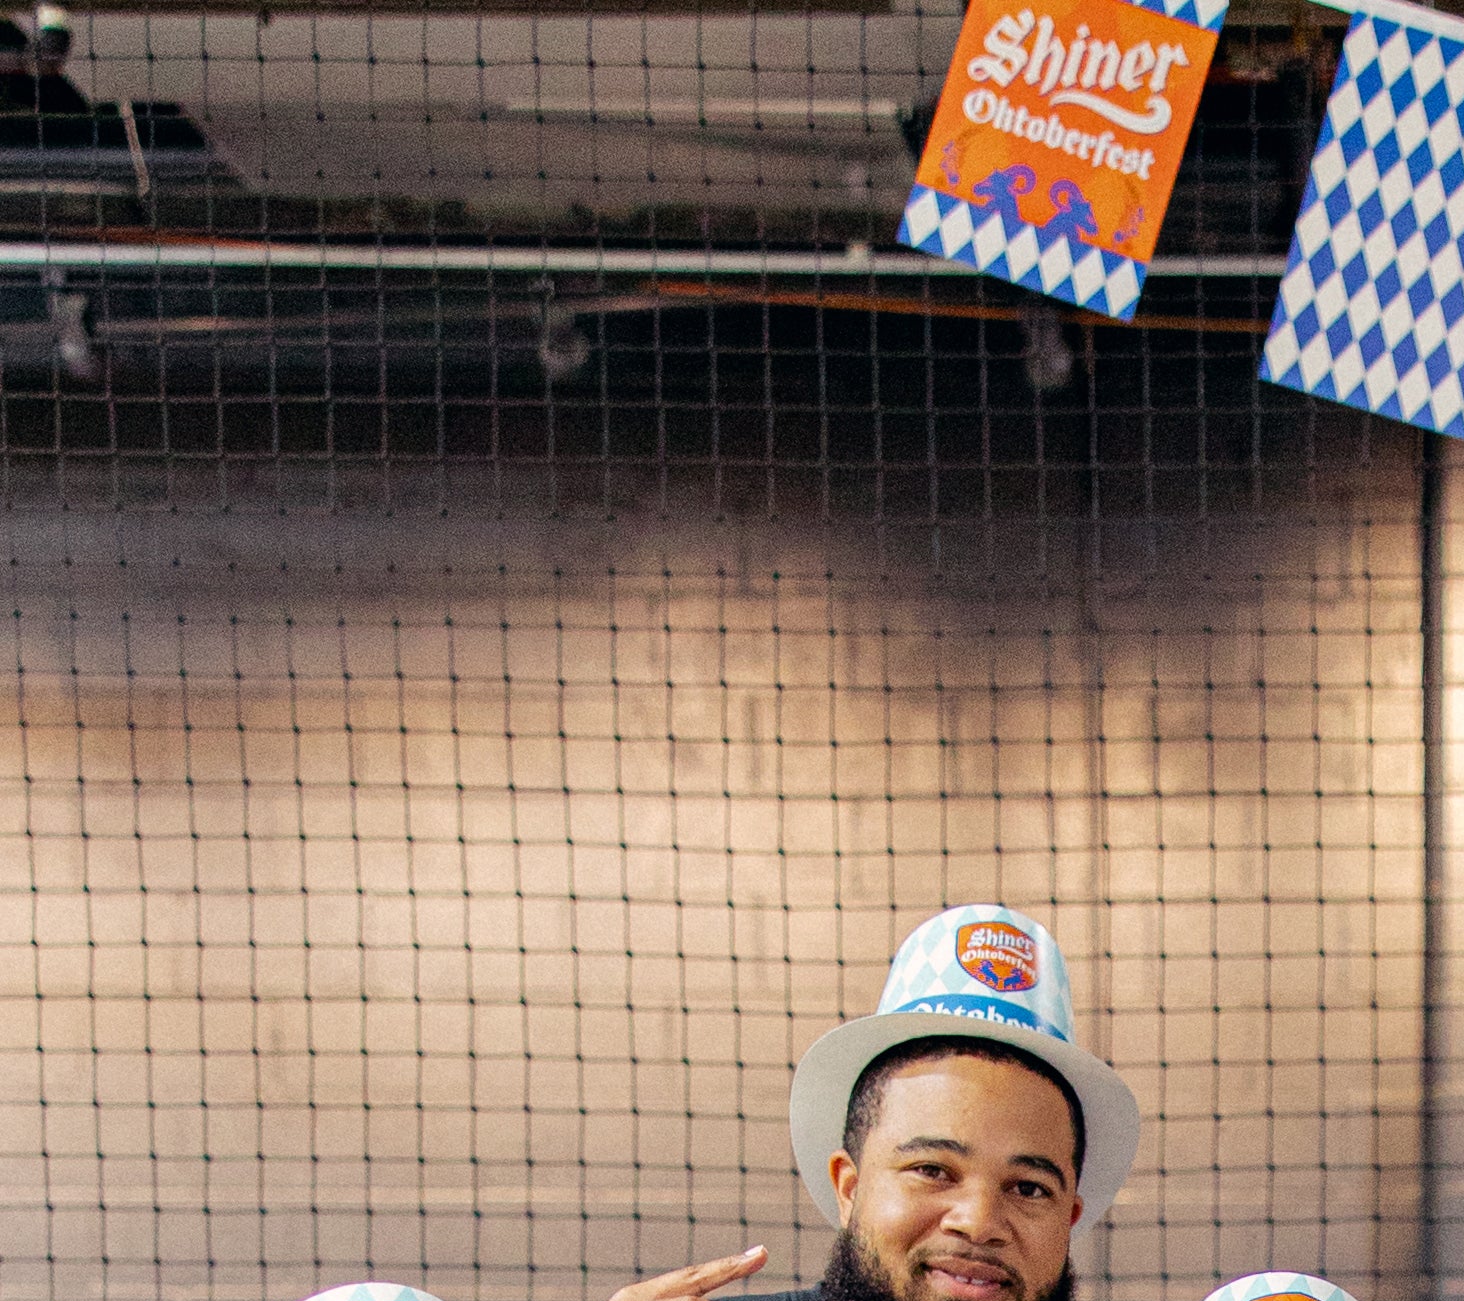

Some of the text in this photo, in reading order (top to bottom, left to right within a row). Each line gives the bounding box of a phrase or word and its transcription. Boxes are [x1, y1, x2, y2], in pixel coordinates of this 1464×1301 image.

[967, 8, 1189, 97] Shiner
[962, 88, 1155, 180] Oktoberfest
[966, 927, 1034, 950] Shiner
